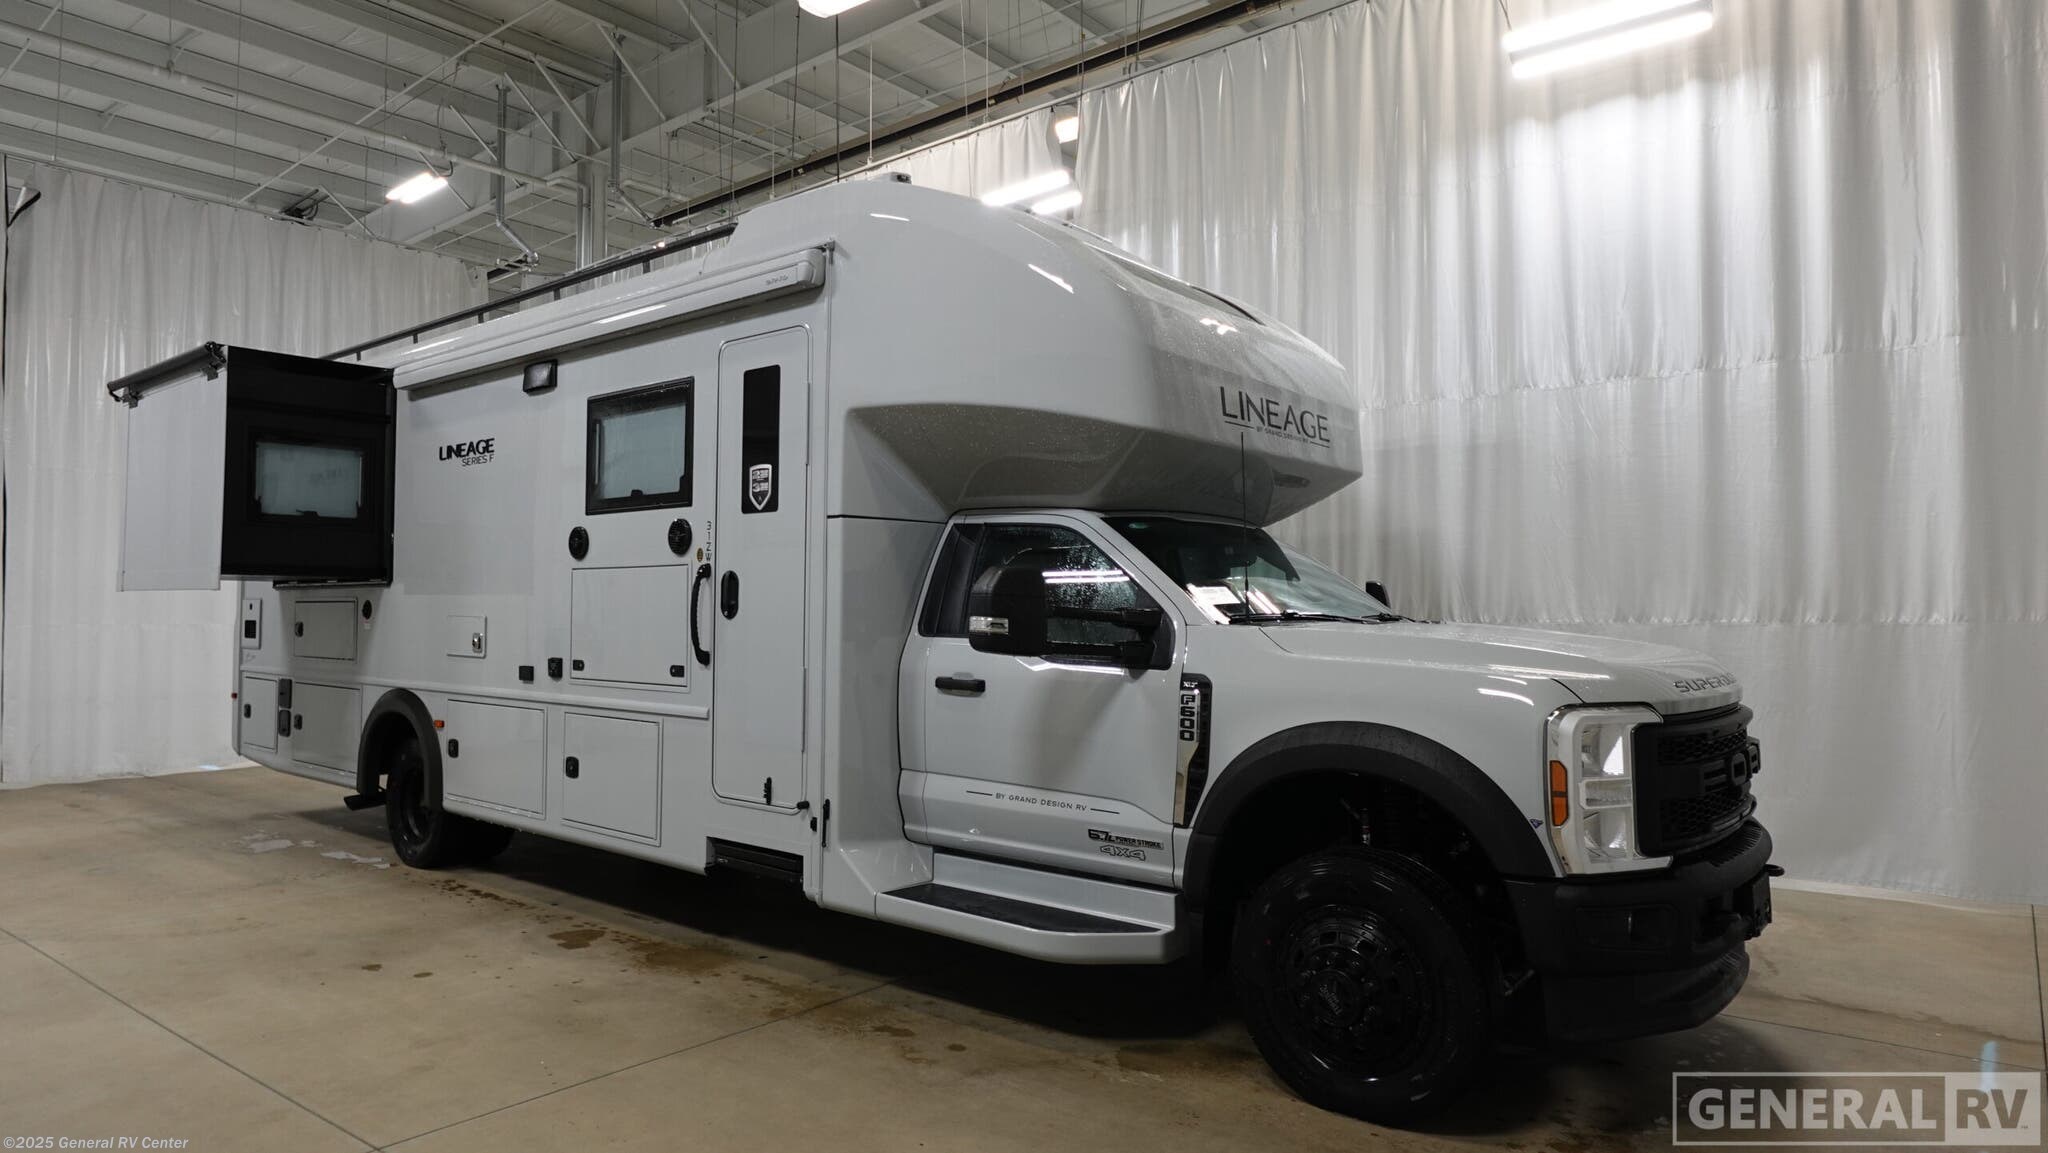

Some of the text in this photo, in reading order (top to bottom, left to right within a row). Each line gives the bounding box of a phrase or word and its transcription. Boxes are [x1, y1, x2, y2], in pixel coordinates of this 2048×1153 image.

[1220, 386, 1331, 443] LINEAGE
[439, 437, 495, 461] LINEAGE
[461, 453, 495, 467] SERIES F
[1180, 694, 1196, 742] F600
[995, 792, 1088, 812] BY GRAND DESIGN RV
